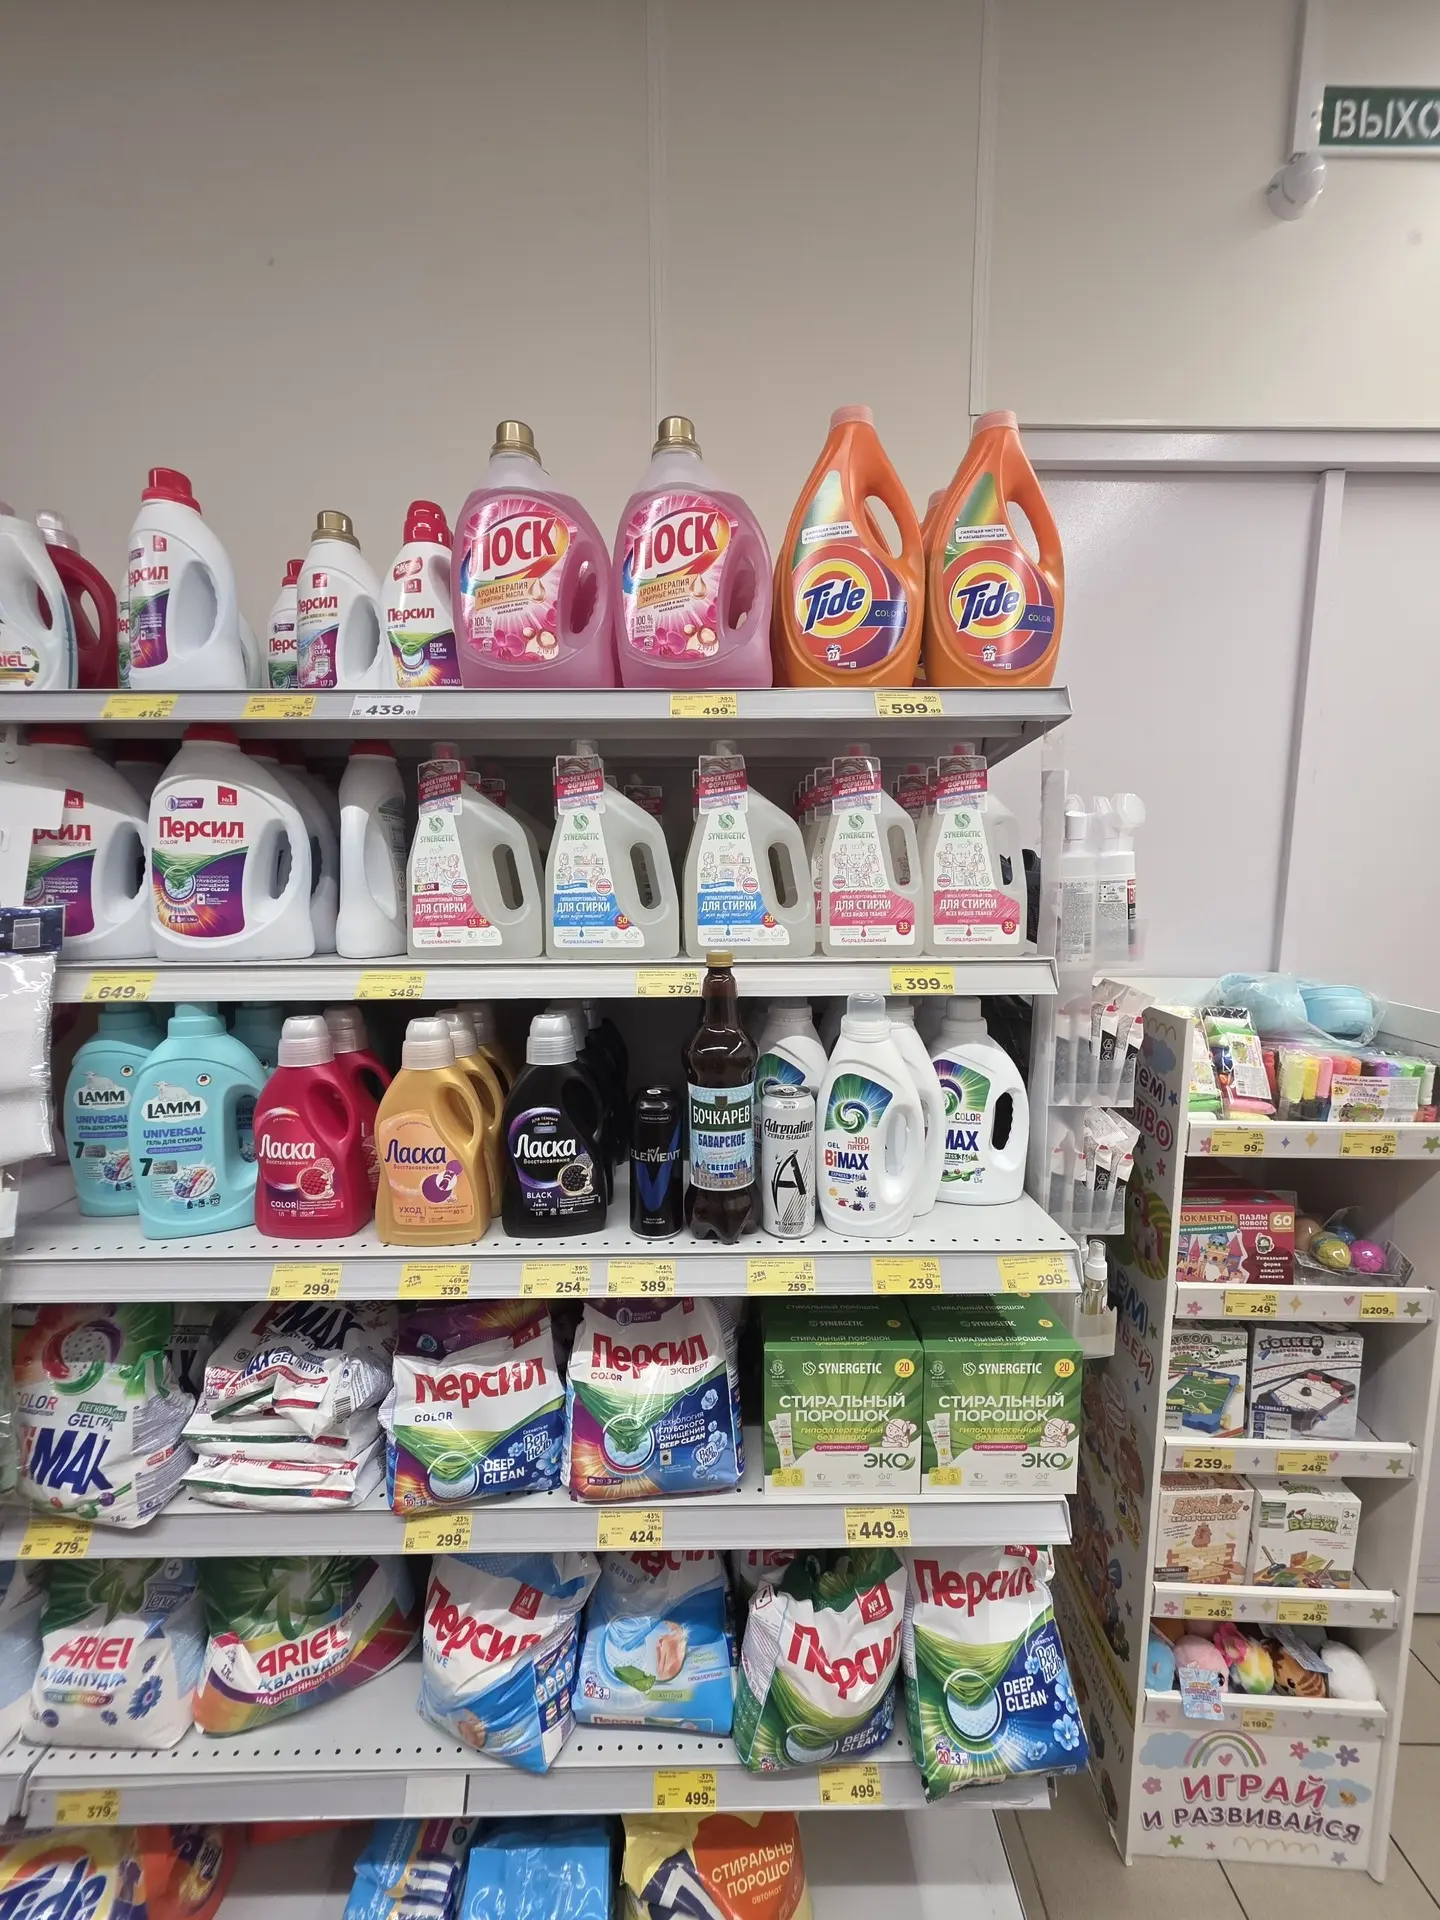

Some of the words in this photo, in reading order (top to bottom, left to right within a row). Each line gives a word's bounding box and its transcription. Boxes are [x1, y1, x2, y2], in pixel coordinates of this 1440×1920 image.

[477, 581, 528, 597] АРОМАТЕРАПИЯ
[638, 578, 690, 596] АРОМАТЕРАПИЯ
[802, 579, 866, 633] Tide
[955, 581, 1021, 633] Tide
[388, 607, 435, 623] Персил
[1028, 614, 1051, 622] COLOR
[829, 651, 838, 660] 27
[984, 651, 993, 660] 27
[939, 771, 985, 785] ЭФФЕКТИВНАЯ
[947, 779, 978, 788] ФОРМУЛА
[159, 816, 244, 842] Персил
[563, 832, 600, 841] SYNERGETIC
[708, 832, 746, 840] SYNERGETIC
[839, 831, 874, 840] SYNERGETIC
[944, 830, 981, 839] SYNERGETIC
[415, 903, 431, 915] ДЛЯ
[433, 902, 467, 913] СТИРКИ
[557, 903, 573, 914] ДЛЯ
[576, 901, 610, 912] СТИРКИ
[702, 901, 720, 912] ДЛЯ
[722, 900, 757, 910] СТИРКИ
[834, 901, 855, 912] ДЛЯ
[856, 899, 891, 910] СТИРКИ
[939, 900, 959, 911] ДЛЯ
[961, 899, 997, 909] СТИРКИ
[764, 915, 774, 923] 50
[899, 922, 908, 930] 33
[1004, 921, 1014, 929] 33
[78, 1091, 125, 1106] LAMM
[147, 1100, 201, 1119] LAMM
[693, 1105, 750, 1125] БОЧКАРЕВ
[955, 1112, 982, 1122] COLOR
[76, 1114, 128, 1124] UNIVERSAL
[764, 1118, 814, 1135] Adrenaline
[143, 1127, 206, 1139] UNIVERSAL
[177, 1136, 202, 1144] СТИРКИ
[698, 1133, 746, 1148] БАВАРСКОЕ
[767, 1132, 785, 1140] ZERO
[785, 1132, 810, 1140] SUGAR
[854, 1136, 869, 1145] 100
[73, 1141, 85, 1159] 7
[259, 1133, 316, 1160] Ласка
[384, 1139, 447, 1164] Ласка
[513, 1133, 577, 1158] Ласка
[827, 1141, 840, 1149] GEL
[847, 1143, 870, 1151] ПЯТЕН
[139, 1158, 153, 1177] 7
[523, 1157, 571, 1165] Восстановление
[824, 1149, 870, 1171] BiMAX
[526, 1191, 553, 1199] BLACK
[270, 1200, 297, 1209] COLOR
[399, 1206, 423, 1216] УХОД
[1199, 1214, 1233, 1222] МЕЧТЫ
[1273, 1214, 1293, 1226] 60
[1259, 1335, 1325, 1351] ХОККЕЙ
[1336, 1340, 1347, 1348] 3+
[591, 1332, 709, 1380] Персил
[670, 1361, 709, 1376] ЭКСПЕРТ
[818, 1362, 882, 1375] SYNERGETIC
[899, 1361, 910, 1373] 20
[978, 1362, 1042, 1375] SYNERGETIC
[1059, 1362, 1070, 1372] 20
[414, 1357, 547, 1408] Персил
[590, 1371, 623, 1382] COLOR
[779, 1392, 906, 1408] СТИРАЛЬНЫЙ
[938, 1391, 1065, 1408] СТИРАЛЬНЫЙ
[68, 1413, 95, 1429] GEL
[414, 1412, 453, 1423] COLOR
[658, 1411, 704, 1426] ТЕХНОЛОГИЯ
[795, 1410, 890, 1422] ПОРОШОК
[954, 1409, 1050, 1422] ПОРОШОК
[658, 1418, 705, 1434] ГЛУБОКОГО
[801, 1427, 883, 1435] гипоаллергенный
[959, 1426, 1042, 1435] гипоаллергенный
[522, 1431, 549, 1452] Вер
[658, 1426, 705, 1442] ОЧИЩЕНИЯ
[659, 1440, 680, 1449] DEEP
[680, 1433, 706, 1445] CLEAN
[483, 1458, 515, 1473] DEEP
[863, 1453, 909, 1469] ЭКО
[1021, 1453, 1067, 1468] ЭКО
[483, 1468, 525, 1485] CLEAN
[1343, 1510, 1356, 1519] 3+
[1288, 1519, 1339, 1532] ВСЕХ!
[913, 1559, 1036, 1618] Персил
[867, 1588, 886, 1614] №1
[257, 1625, 350, 1678] ARIEL
[1036, 1644, 1057, 1666] Вер
[1043, 1658, 1064, 1684] Нель
[255, 1675, 326, 1705] НАСЫЩЕННЫЙ
[1003, 1675, 1035, 1696] DEEP
[1006, 1690, 1048, 1712] CLEAN
[841, 1732, 880, 1753] CLEAN
[843, 1726, 875, 1744] DEEP
[937, 1751, 949, 1763] 20
[1182, 1773, 1328, 1811] ИГРАЙ
[1143, 1810, 1163, 1830] И
[1173, 1805, 1361, 1844] РАЗВИВАЙСЯ
[752, 1885, 783, 1905] автомат
